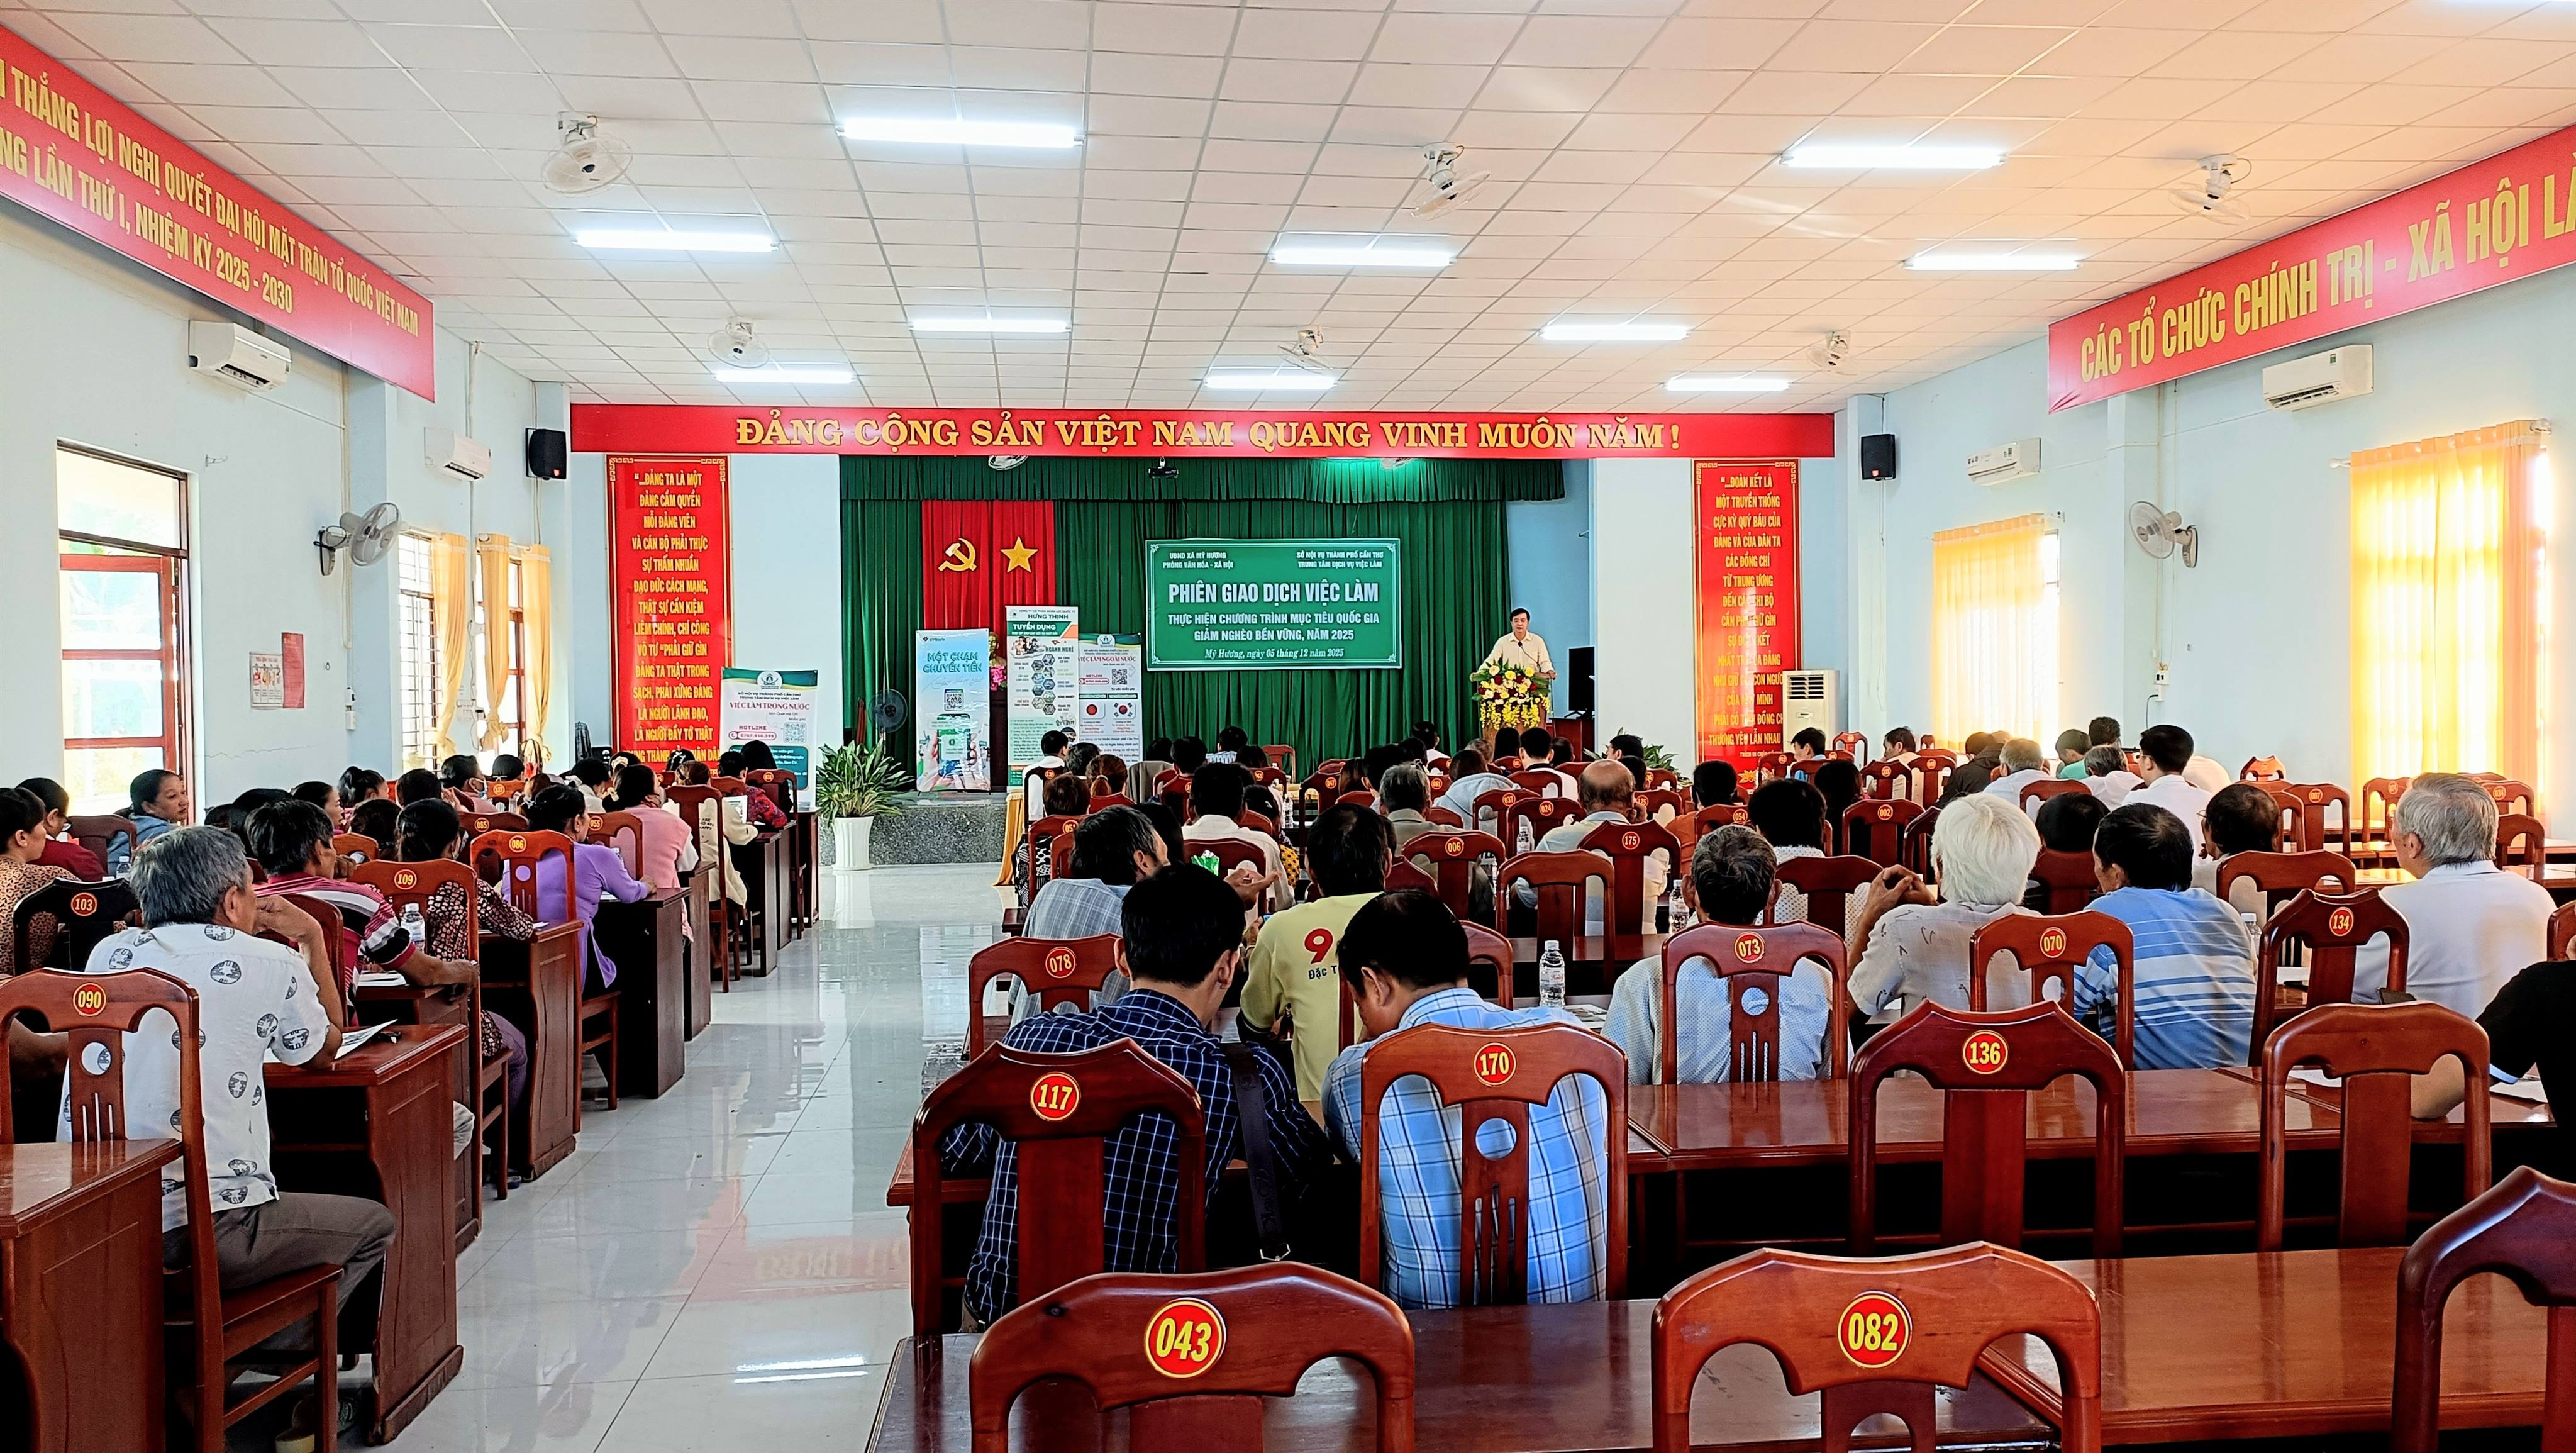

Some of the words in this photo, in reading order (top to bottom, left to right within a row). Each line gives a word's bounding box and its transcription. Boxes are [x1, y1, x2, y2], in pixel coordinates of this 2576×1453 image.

[11, 65, 80, 142] THẮNG
[85, 111, 114, 164] LỢI
[118, 131, 160, 196] NGHỊ
[165, 161, 212, 218] QUYẾT
[216, 192, 240, 237] ĐẠI
[243, 208, 265, 252] HỘI
[269, 224, 296, 268] MẶT
[298, 241, 328, 286] TRẬN
[330, 257, 345, 294] TỔ
[347, 272, 374, 311] QUỐC
[375, 289, 395, 326] VIỆT
[397, 302, 418, 337] NAM
[34, 142, 73, 201] LẦN
[78, 170, 115, 221] THỨ
[119, 192, 131, 235] I,
[135, 201, 189, 260] NHIỆM
[193, 232, 213, 272] KỲ
[216, 248, 250, 292] 2025
[253, 279, 259, 287] -
[262, 272, 292, 313] 2030
[2081, 323, 2122, 382] CÁC
[2128, 296, 2156, 368] TỔ
[2162, 287, 2226, 358] CHỨC
[2234, 260, 2318, 335] CHÍNH
[2326, 239, 2373, 309] TRỊ
[2385, 257, 2396, 272] -
[2407, 199, 2455, 282] XÃ
[2467, 177, 2529, 269] HỘI
[736, 409, 844, 445] ĐẢNG
[855, 412, 960, 453] CỘNG
[971, 411, 1045, 446] SẢN
[1055, 413, 1142, 453] VIỆT
[1153, 421, 1234, 446] NAM
[1249, 421, 1372, 452] QUANG
[1380, 422, 1468, 447] VINH
[1478, 416, 1578, 448] MUÔN
[665, 473, 674, 486] TA
[676, 470, 686, 486] LÀ
[687, 470, 702, 488] MỘT
[1750, 472, 1762, 488] KẾT
[1764, 473, 1772, 487] LÀ
[640, 489, 659, 507] ĐẢNG
[660, 489, 675, 507] CẦM
[677, 489, 701, 509] QUYỀN
[1716, 493, 1729, 510] MỘT
[1731, 491, 1757, 508] TRUYỀN
[1758, 491, 1780, 508] THỐNG
[643, 509, 657, 528] MỖI
[658, 511, 678, 528] ĐẢNG
[679, 513, 696, 528] VIÊN
[1713, 514, 1726, 530] CỰC
[1728, 513, 1737, 528] KỲ
[1738, 513, 1752, 529] QUÝ
[1753, 513, 1767, 528] BÁU
[1768, 511, 1781, 528] CỦA
[1296, 550, 1305, 559] SỞ
[1306, 551, 1316, 559] NỘI
[1223, 561, 1233, 569] HỘI
[1355, 560, 1368, 569] VIỆC
[1169, 579, 1216, 603] PHIÊN
[1221, 583, 1258, 603] GIAO
[1263, 583, 1301, 606] DỊCH
[1304, 579, 1340, 606] VIỆC
[1345, 579, 1379, 602] LÀM
[1168, 613, 1192, 626] THỰC
[1194, 612, 1217, 626] HIỆN
[1219, 613, 1258, 625] CHƯƠNG
[1260, 611, 1288, 624] TRÌNH
[1290, 613, 1311, 626] MỤC
[1314, 611, 1333, 623] TIÊU
[1336, 610, 1361, 625] QUỐC
[1364, 613, 1379, 623] GIA
[1194, 628, 1219, 641] GIẢM
[1221, 628, 1253, 641] NGHÈO
[1255, 627, 1274, 640] BỀN
[1277, 628, 1304, 641] VỮNG,
[1307, 628, 1329, 640] NĂM
[1331, 630, 1354, 640] 2025
[927, 651, 949, 664] MỘT
[950, 652, 978, 662] CHẠM
[1205, 649, 1217, 660] Mỹ
[1218, 649, 1245, 659] Hương,
[1246, 649, 1265, 659] ngày
[1266, 649, 1275, 657] 05
[1276, 649, 1299, 659] tháng
[1299, 648, 1308, 657] 12
[1327, 648, 1344, 657] 2025
[923, 662, 960, 673] CHUYỂN
[962, 661, 982, 672] TIỀN
[590, 819, 601, 827] 055
[512, 840, 524, 849] 086
[1448, 841, 1462, 853] 006
[1624, 835, 1637, 846] 175
[397, 874, 413, 886] 109
[74, 898, 92, 911] 103
[2332, 915, 2351, 930] 134
[1304, 928, 1333, 964] 9
[1738, 938, 1760, 956] 073
[2043, 934, 2062, 951] 070
[1049, 954, 1072, 972] 078
[1307, 967, 1327, 981] Đặc
[78, 991, 101, 1009] 090
[1968, 1040, 2002, 1064] 136
[1479, 1052, 1509, 1076] 170
[1037, 1085, 1074, 1111] 117
[1155, 1317, 1211, 1361] 043
[1847, 1313, 1899, 1352] 082
